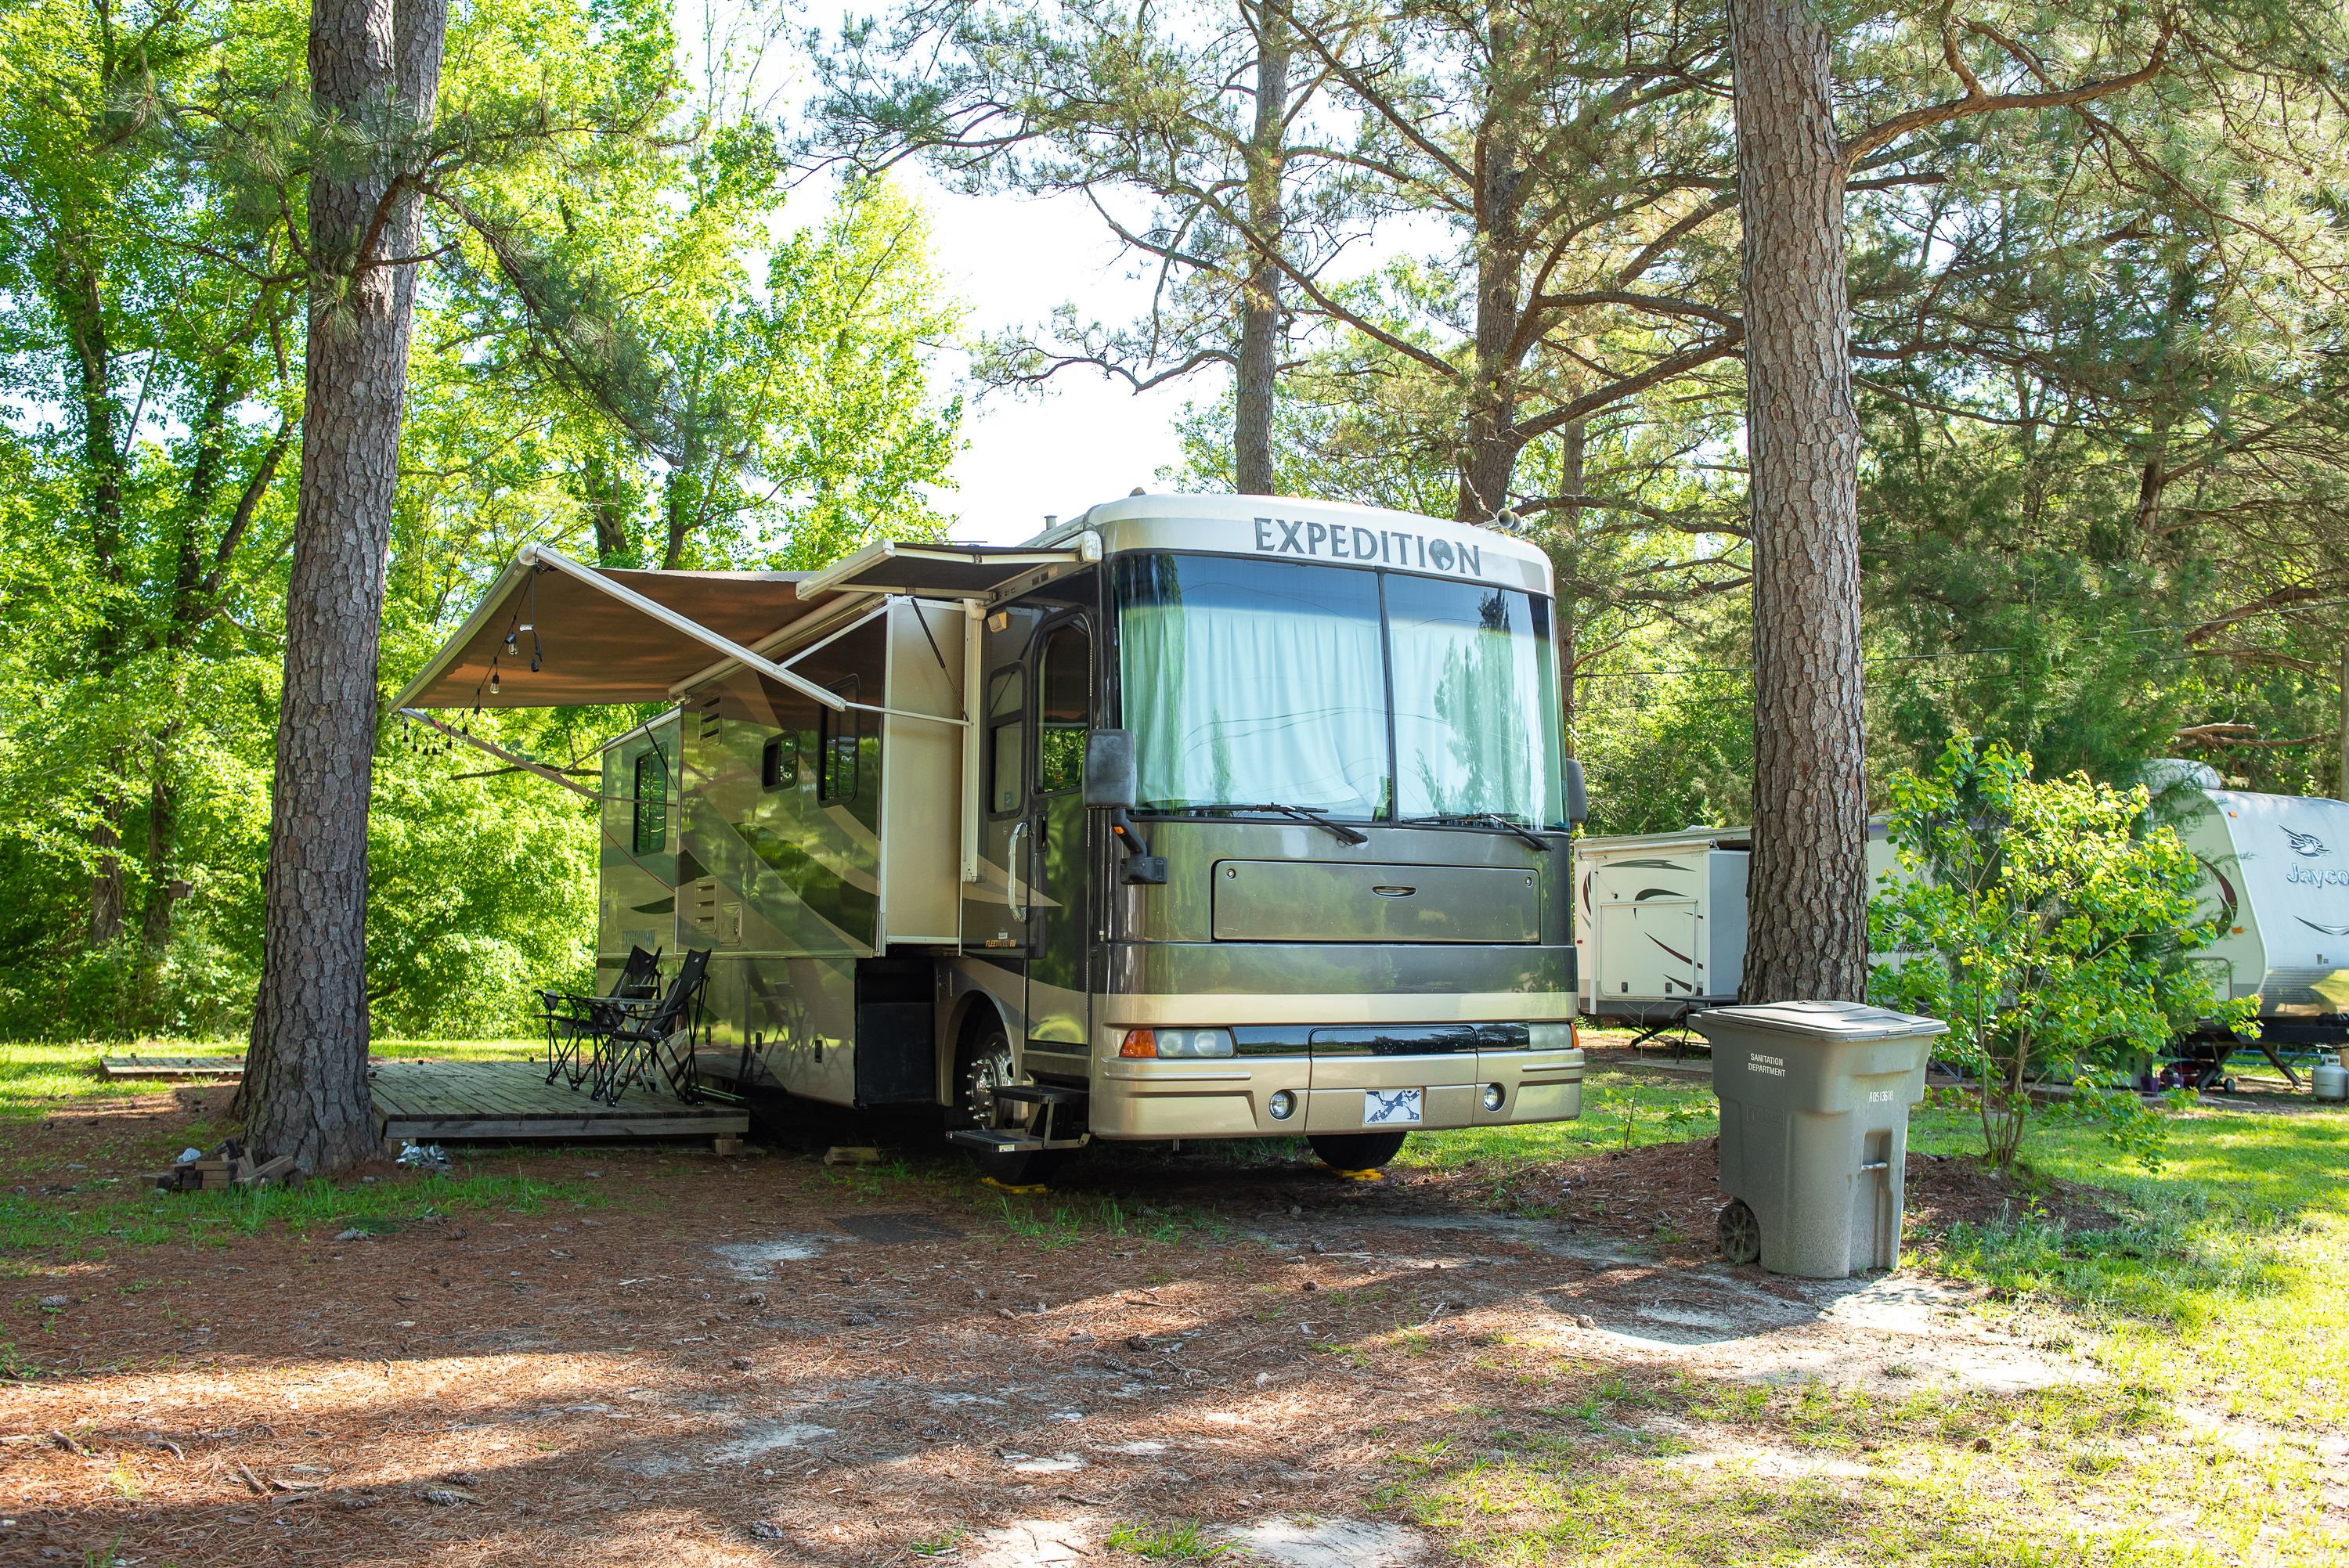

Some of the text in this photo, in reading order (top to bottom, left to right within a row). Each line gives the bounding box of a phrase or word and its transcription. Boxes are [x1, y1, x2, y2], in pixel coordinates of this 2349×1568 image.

[1253, 517, 1481, 577] EXPEDITION
[2286, 862, 2349, 889] Jayco
[1748, 1062, 1786, 1077] DEPARTMENT
[1750, 1052, 1784, 1066] SANITATION
